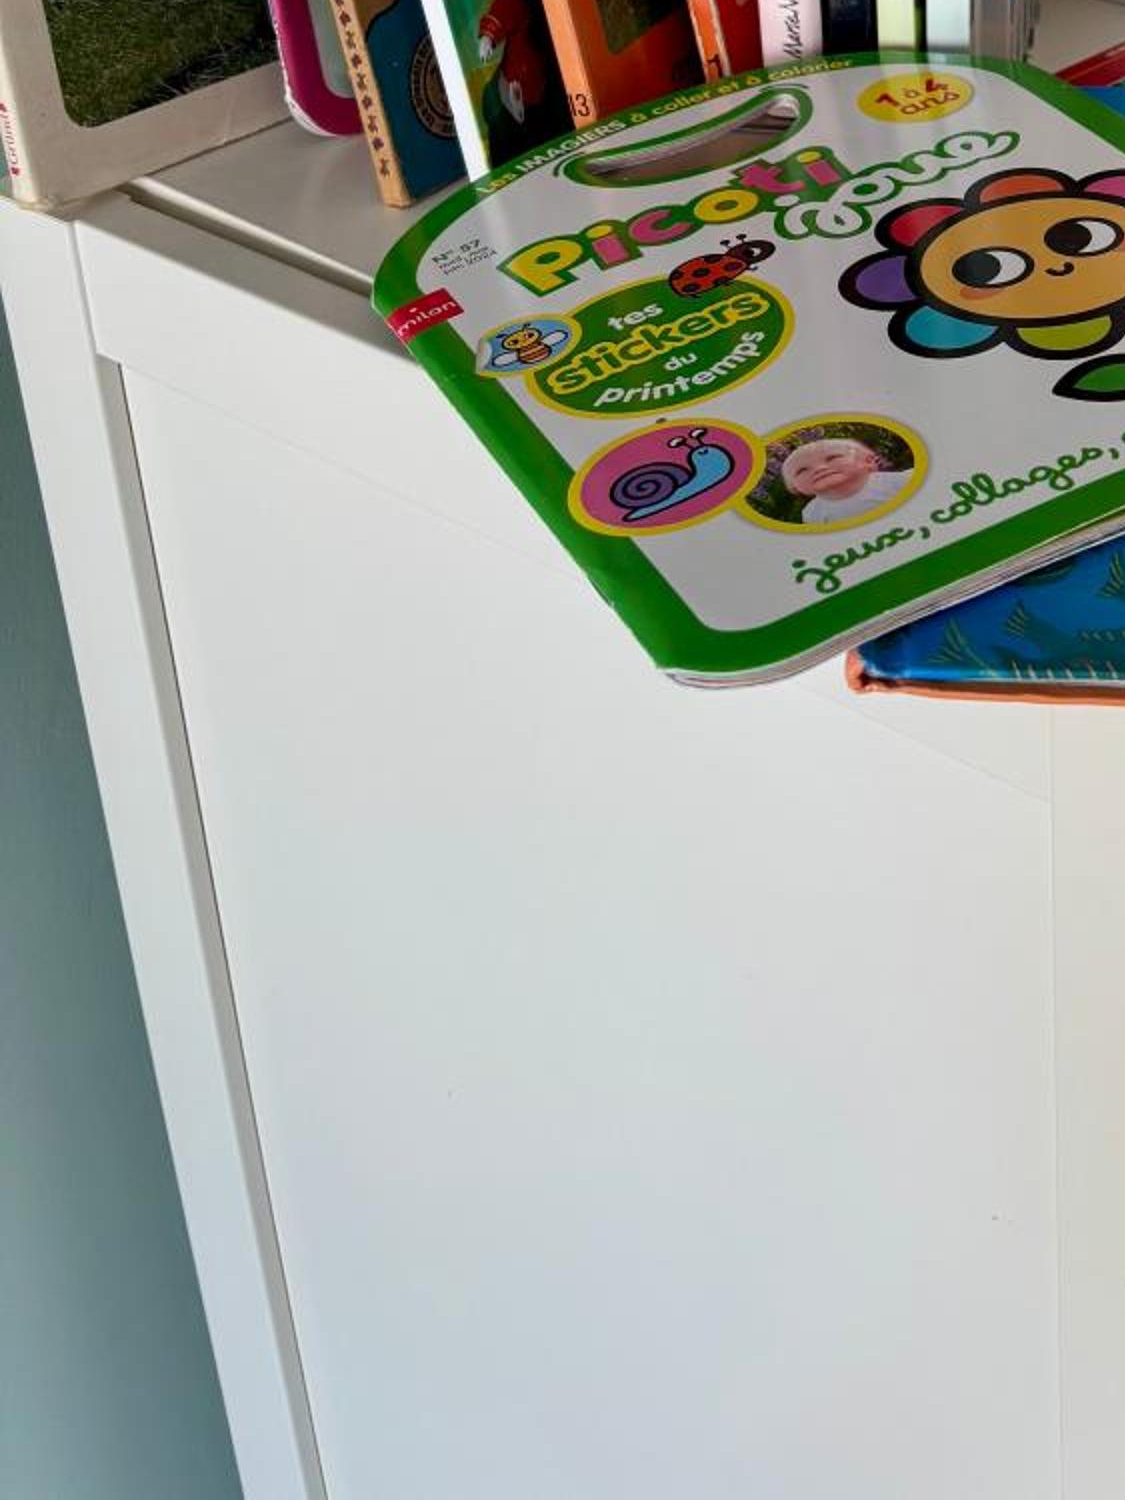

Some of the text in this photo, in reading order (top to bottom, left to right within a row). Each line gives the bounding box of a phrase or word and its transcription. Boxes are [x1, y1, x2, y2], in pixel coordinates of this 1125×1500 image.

[516, 120, 627, 171] IMAGIERS
[651, 90, 715, 115] coller
[718, 80, 740, 95] et
[767, 58, 850, 82] colorier
[568, 92, 590, 118] 13
[900, 91, 961, 115] ans
[773, 131, 1021, 240] joue
[497, 146, 845, 296] Picoti
[396, 298, 457, 337] milan
[607, 303, 663, 331] tes
[592, 330, 766, 407] printemps
[664, 351, 698, 371] du
[791, 522, 931, 594] jeux,
[929, 445, 1120, 527] collages,
